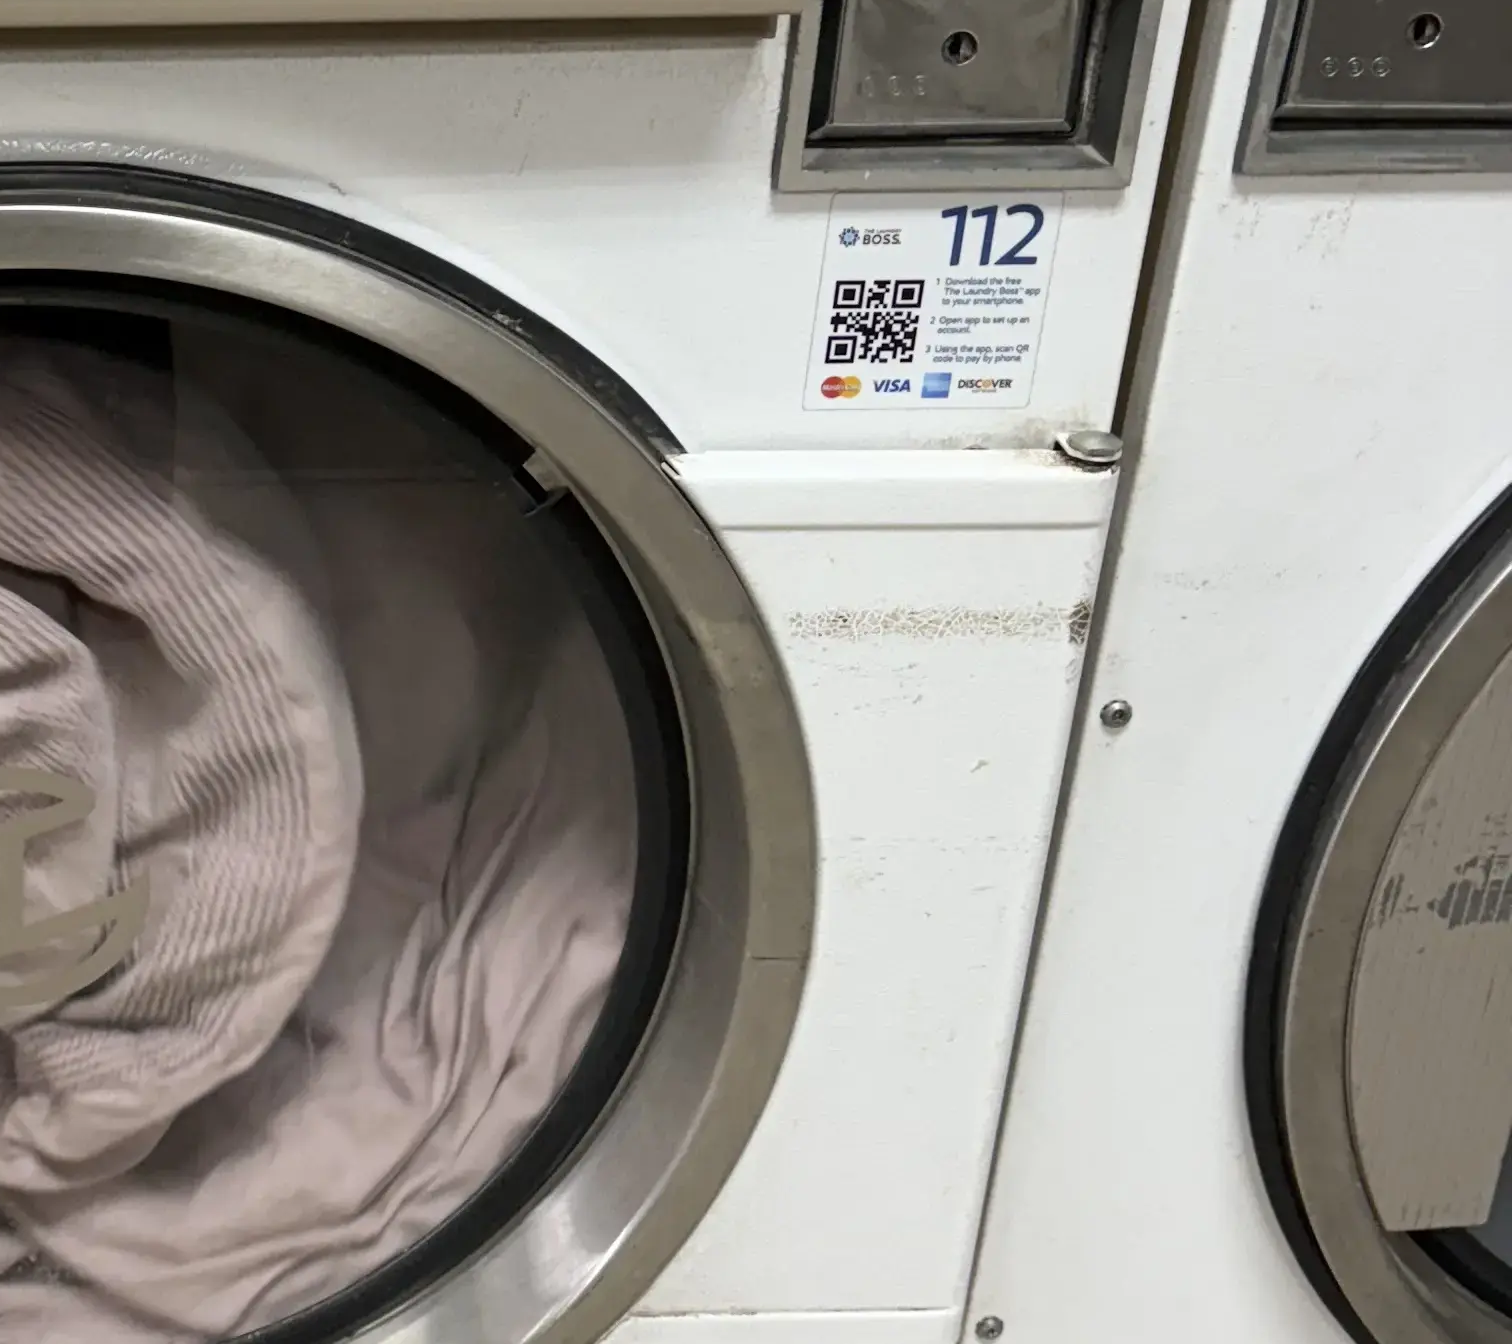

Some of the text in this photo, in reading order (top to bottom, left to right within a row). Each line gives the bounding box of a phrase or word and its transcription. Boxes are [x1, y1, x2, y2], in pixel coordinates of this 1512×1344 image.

[941, 203, 1045, 267] 112
[873, 379, 912, 393] VISA
[957, 378, 1014, 390] DISCOVER
